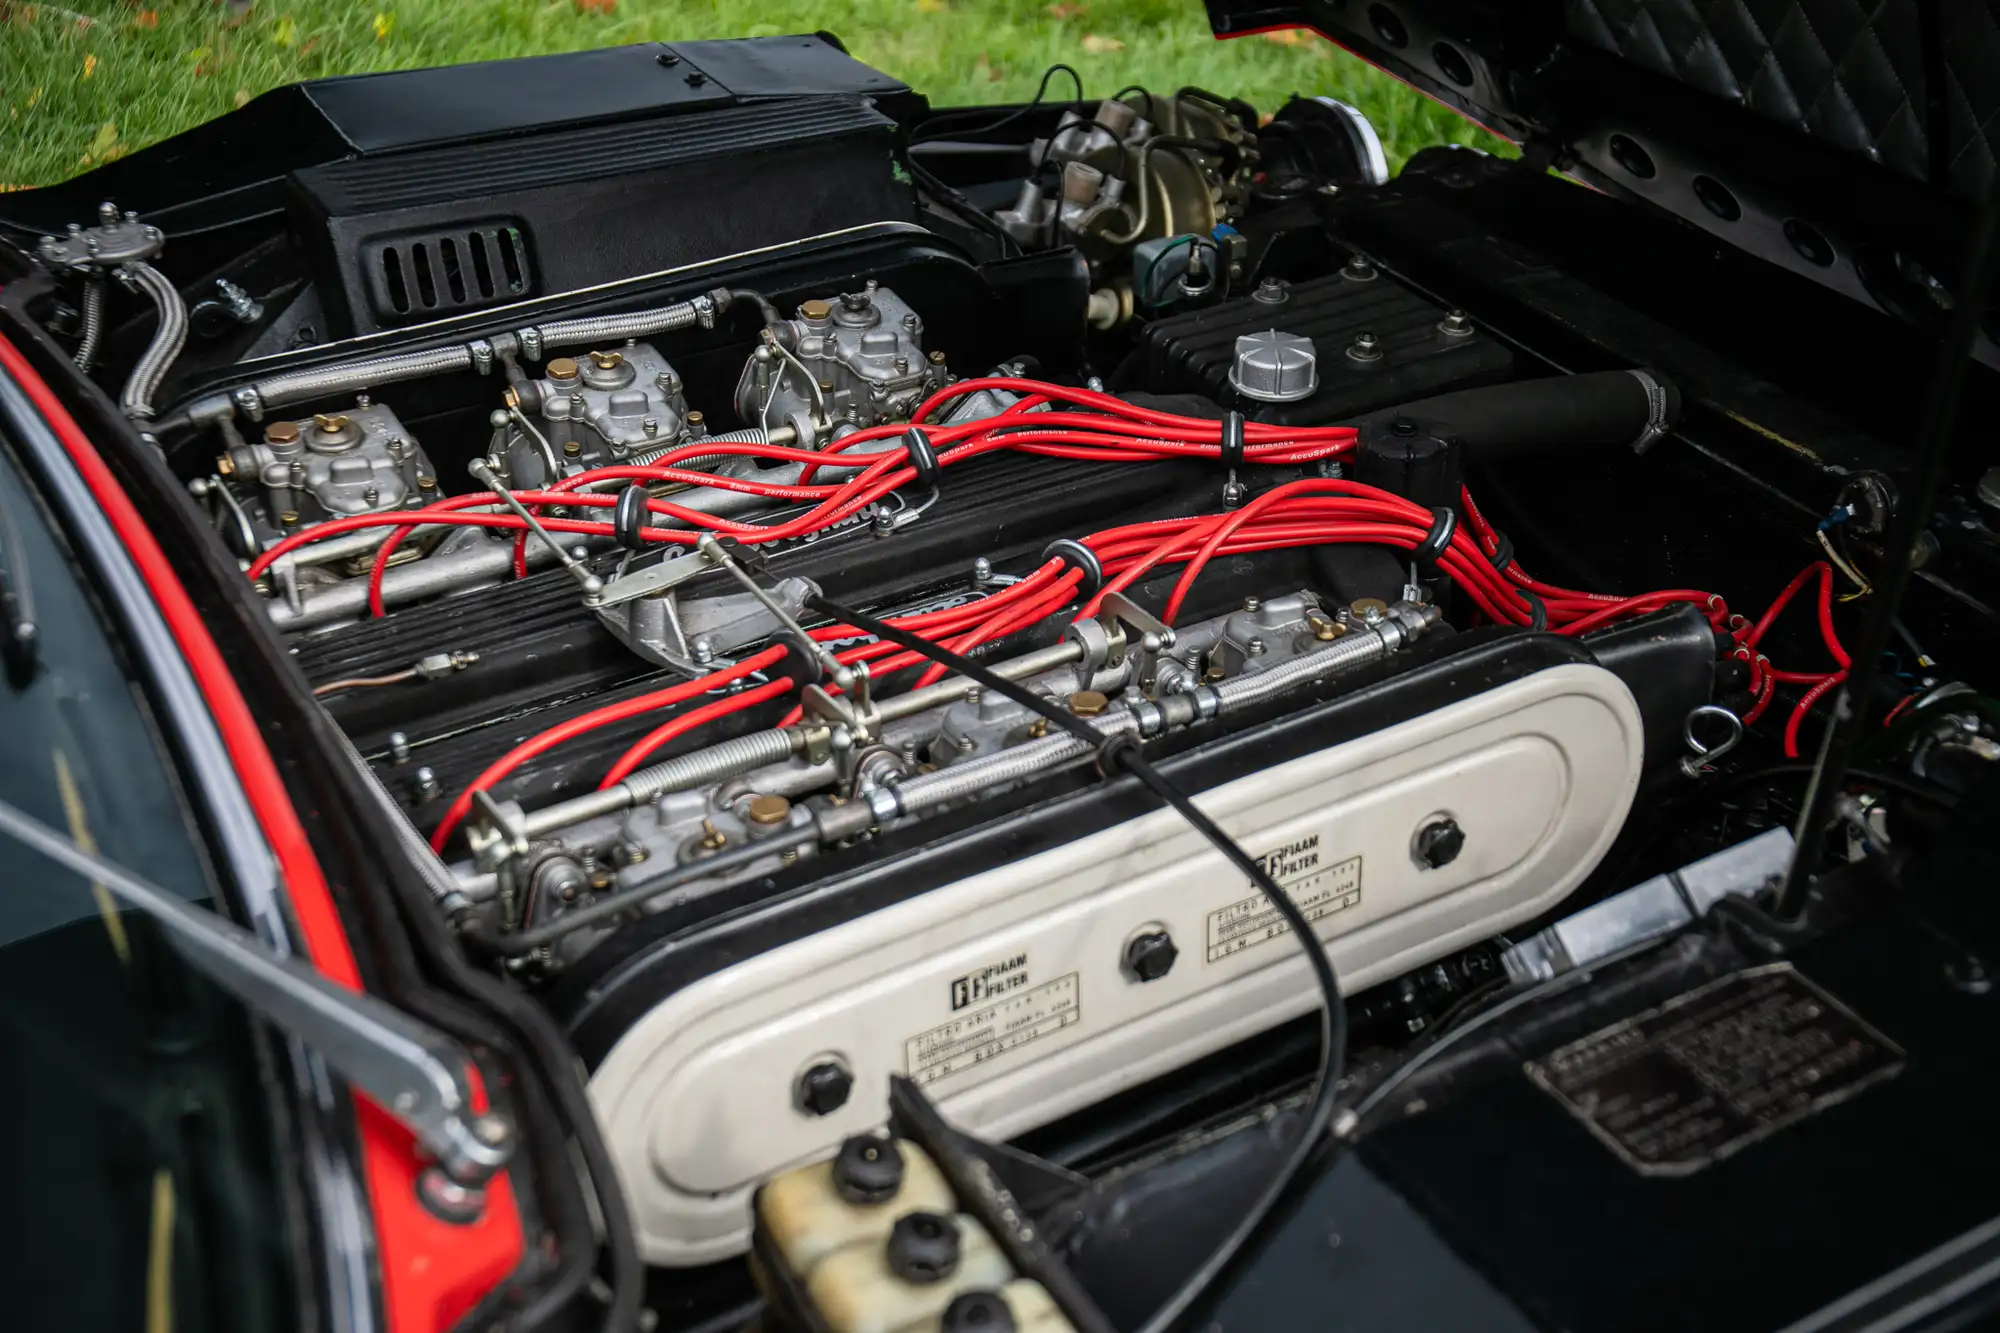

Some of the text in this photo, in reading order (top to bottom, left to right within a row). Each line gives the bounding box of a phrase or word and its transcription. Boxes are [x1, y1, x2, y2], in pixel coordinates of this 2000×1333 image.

[1290, 444, 1341, 461] AccuSpark
[663, 470, 716, 486] AccuSpark
[764, 488, 821, 499] performance
[1284, 834, 1319, 859] FIAAM
[1283, 853, 1319, 877] FILTER
[988, 953, 1028, 979] FIAAM
[988, 971, 1029, 998] FILTER
